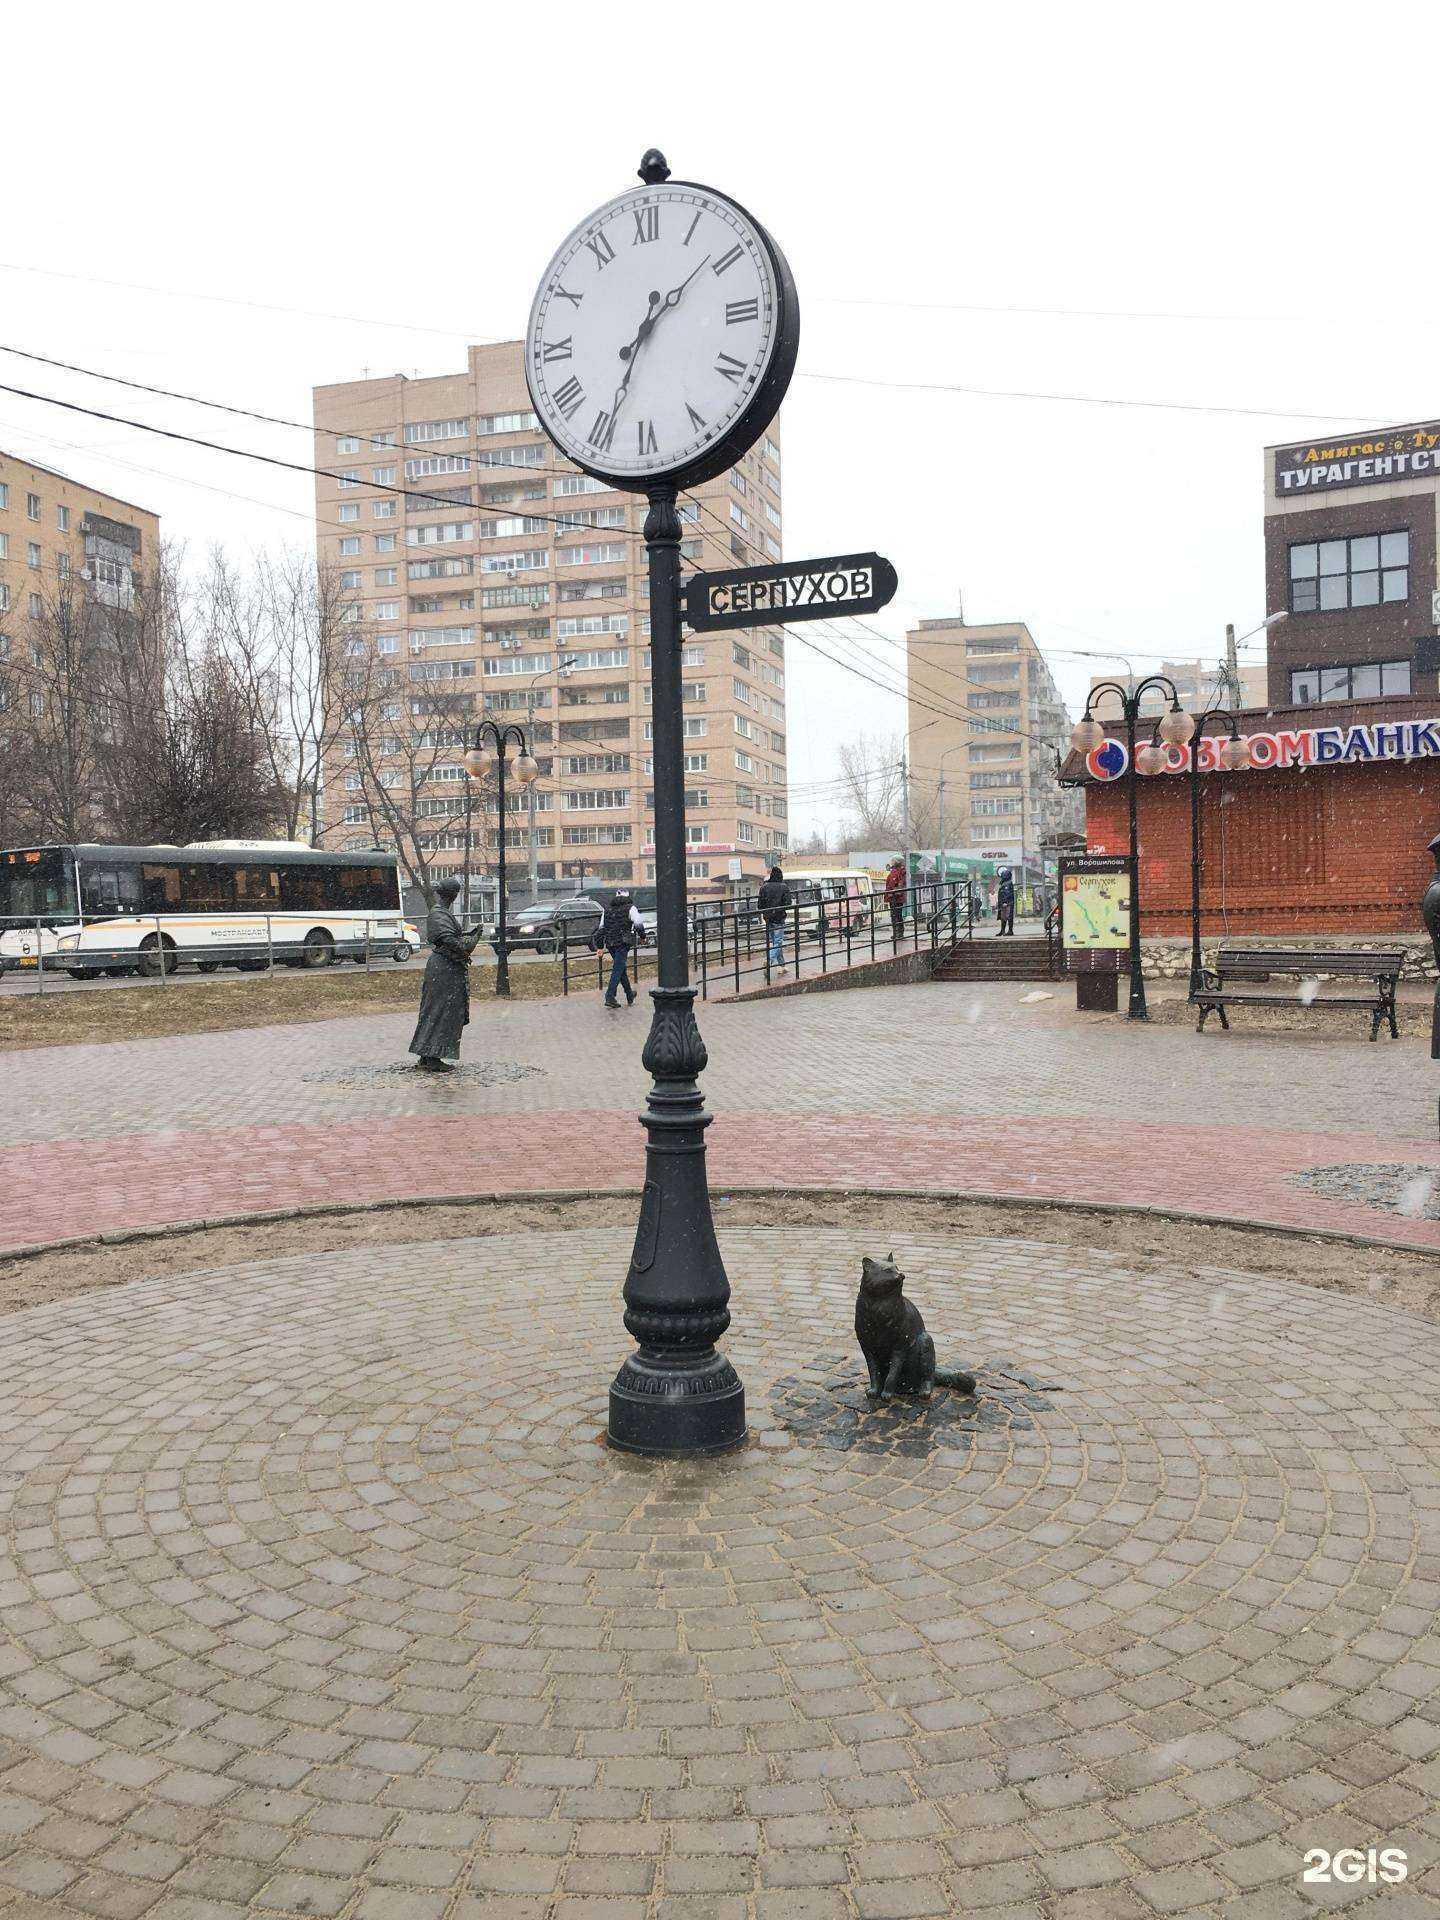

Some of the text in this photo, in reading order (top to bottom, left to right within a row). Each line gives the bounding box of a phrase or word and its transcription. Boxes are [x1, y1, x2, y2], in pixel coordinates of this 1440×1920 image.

[631, 205, 660, 246] XII
[585, 230, 616, 271] XI
[712, 243, 746, 276] II
[553, 283, 584, 310] X
[725, 297, 759, 326] III
[542, 335, 573, 364] IX
[713, 352, 748, 386] IV
[552, 374, 587, 422] VIII
[684, 402, 707, 434] V
[636, 419, 658, 456] VI
[1303, 441, 1386, 464] Амигос
[709, 569, 872, 613] СЕРПУХОВ
